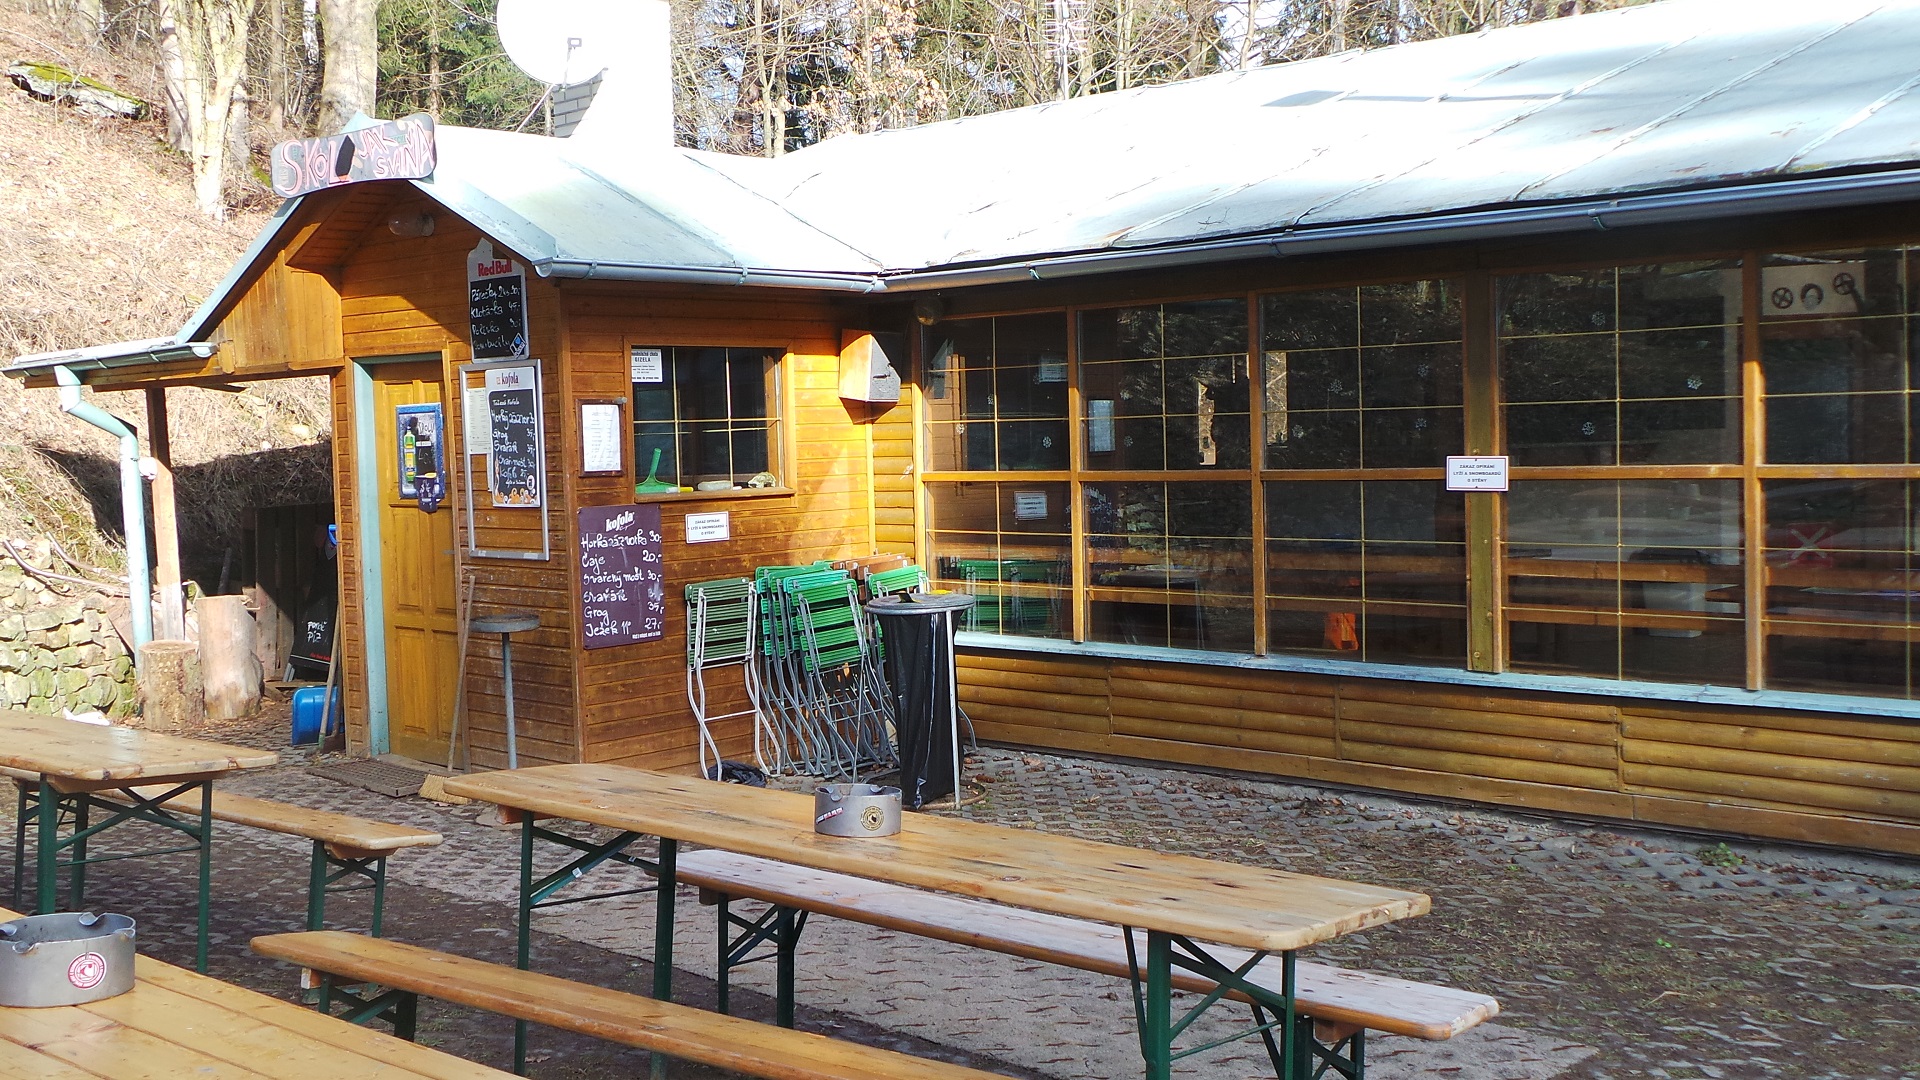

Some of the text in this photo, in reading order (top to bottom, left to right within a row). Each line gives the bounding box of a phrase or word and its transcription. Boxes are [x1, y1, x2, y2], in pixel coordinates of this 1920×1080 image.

[478, 259, 512, 277] Red Bull
[502, 372, 518, 387] kofola
[605, 511, 635, 531] kofola
[581, 552, 606, 575] Čaje
[584, 606, 609, 626] Grog
[585, 621, 618, 637] Ježek
